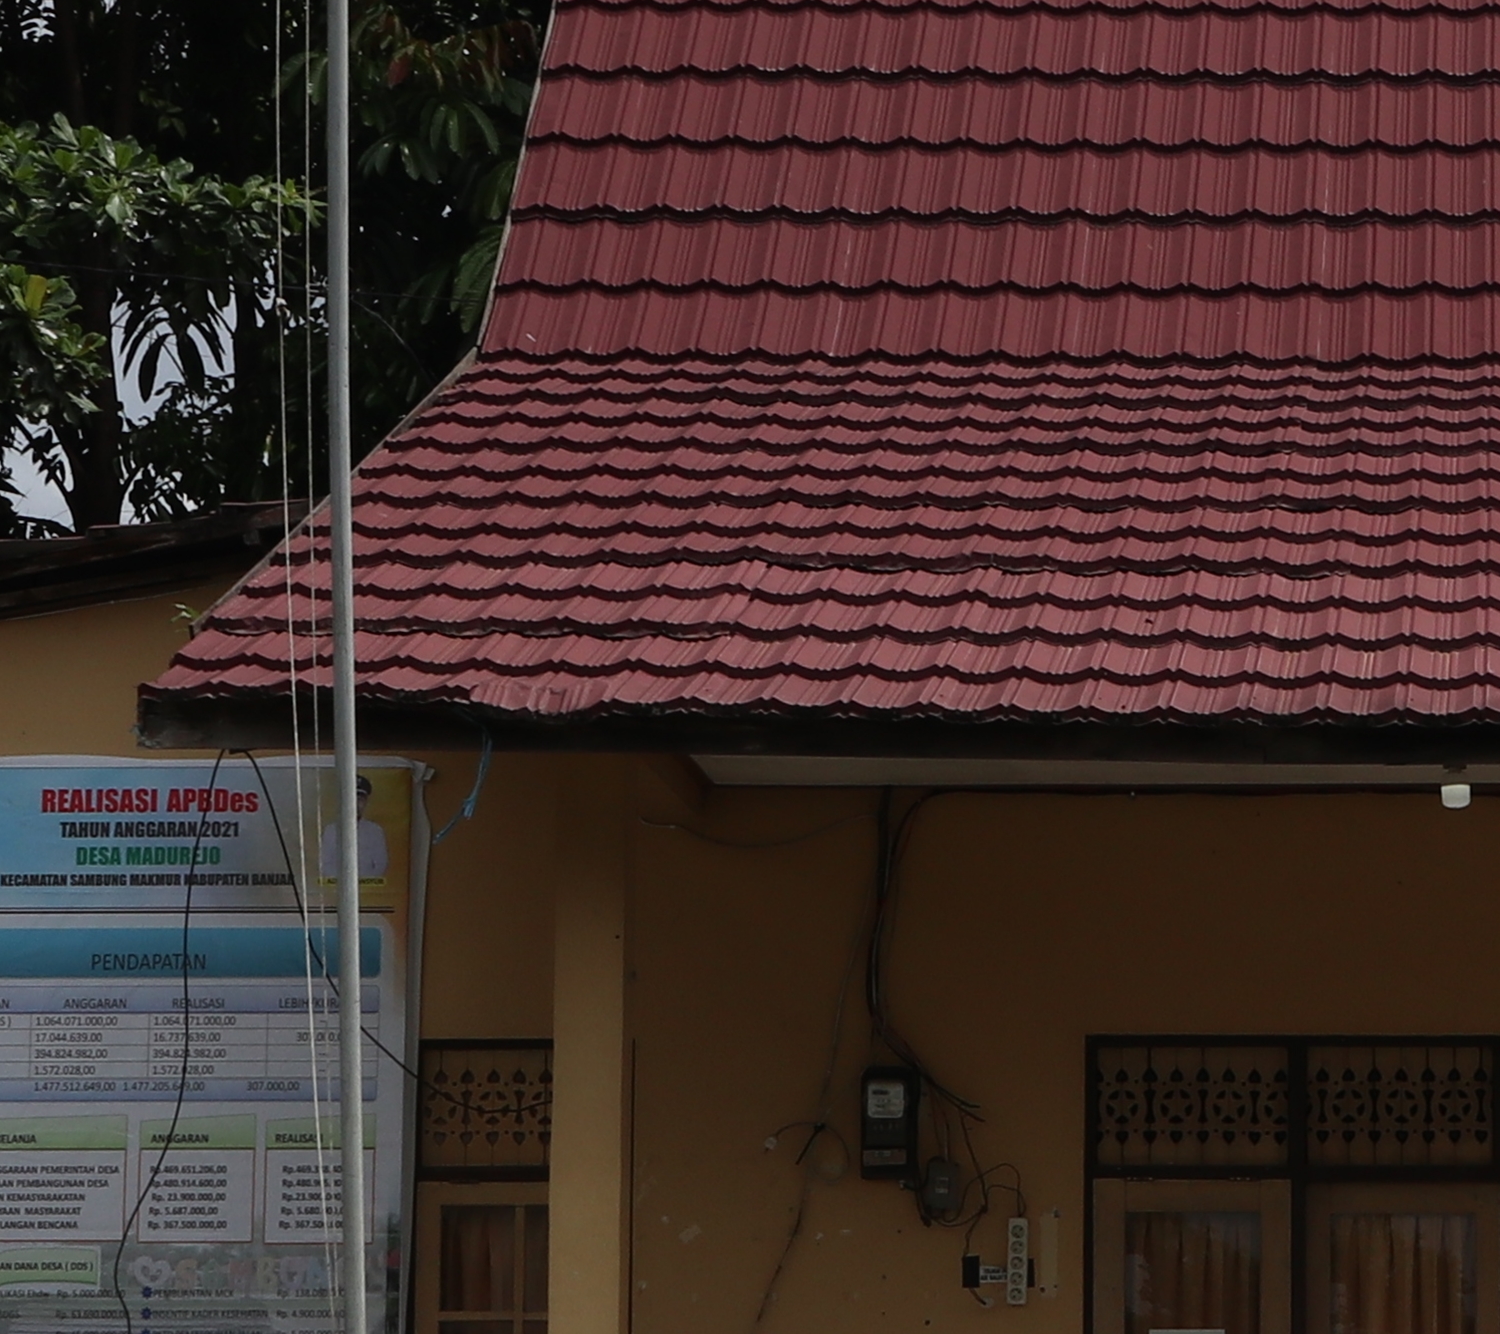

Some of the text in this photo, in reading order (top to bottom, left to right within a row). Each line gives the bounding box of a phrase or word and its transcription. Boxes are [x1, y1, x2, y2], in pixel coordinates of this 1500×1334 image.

[41, 788, 258, 813] REALISASI APBDes
[60, 821, 239, 838] TAHUN ANGGARAN 2021
[75, 846, 220, 865] DESA MADUREJO
[0, 874, 68, 887] KECAMATAN
[70, 874, 128, 887] SAMBUNG
[130, 874, 181, 887] MAKMUR
[90, 953, 206, 972] PENDAPATAN
[64, 998, 127, 1010] ANGGARAN
[150, 1133, 209, 1144] ANGARAN
[40, 1165, 95, 1175] PEMERINTAH
[97, 1165, 120, 1175] DESA
[16, 1179, 85, 1189] PEMBANGUNAN
[87, 1179, 109, 1189] DESA
[14, 1262, 39, 1272] DANA
[41, 1262, 62, 1272] DESA
